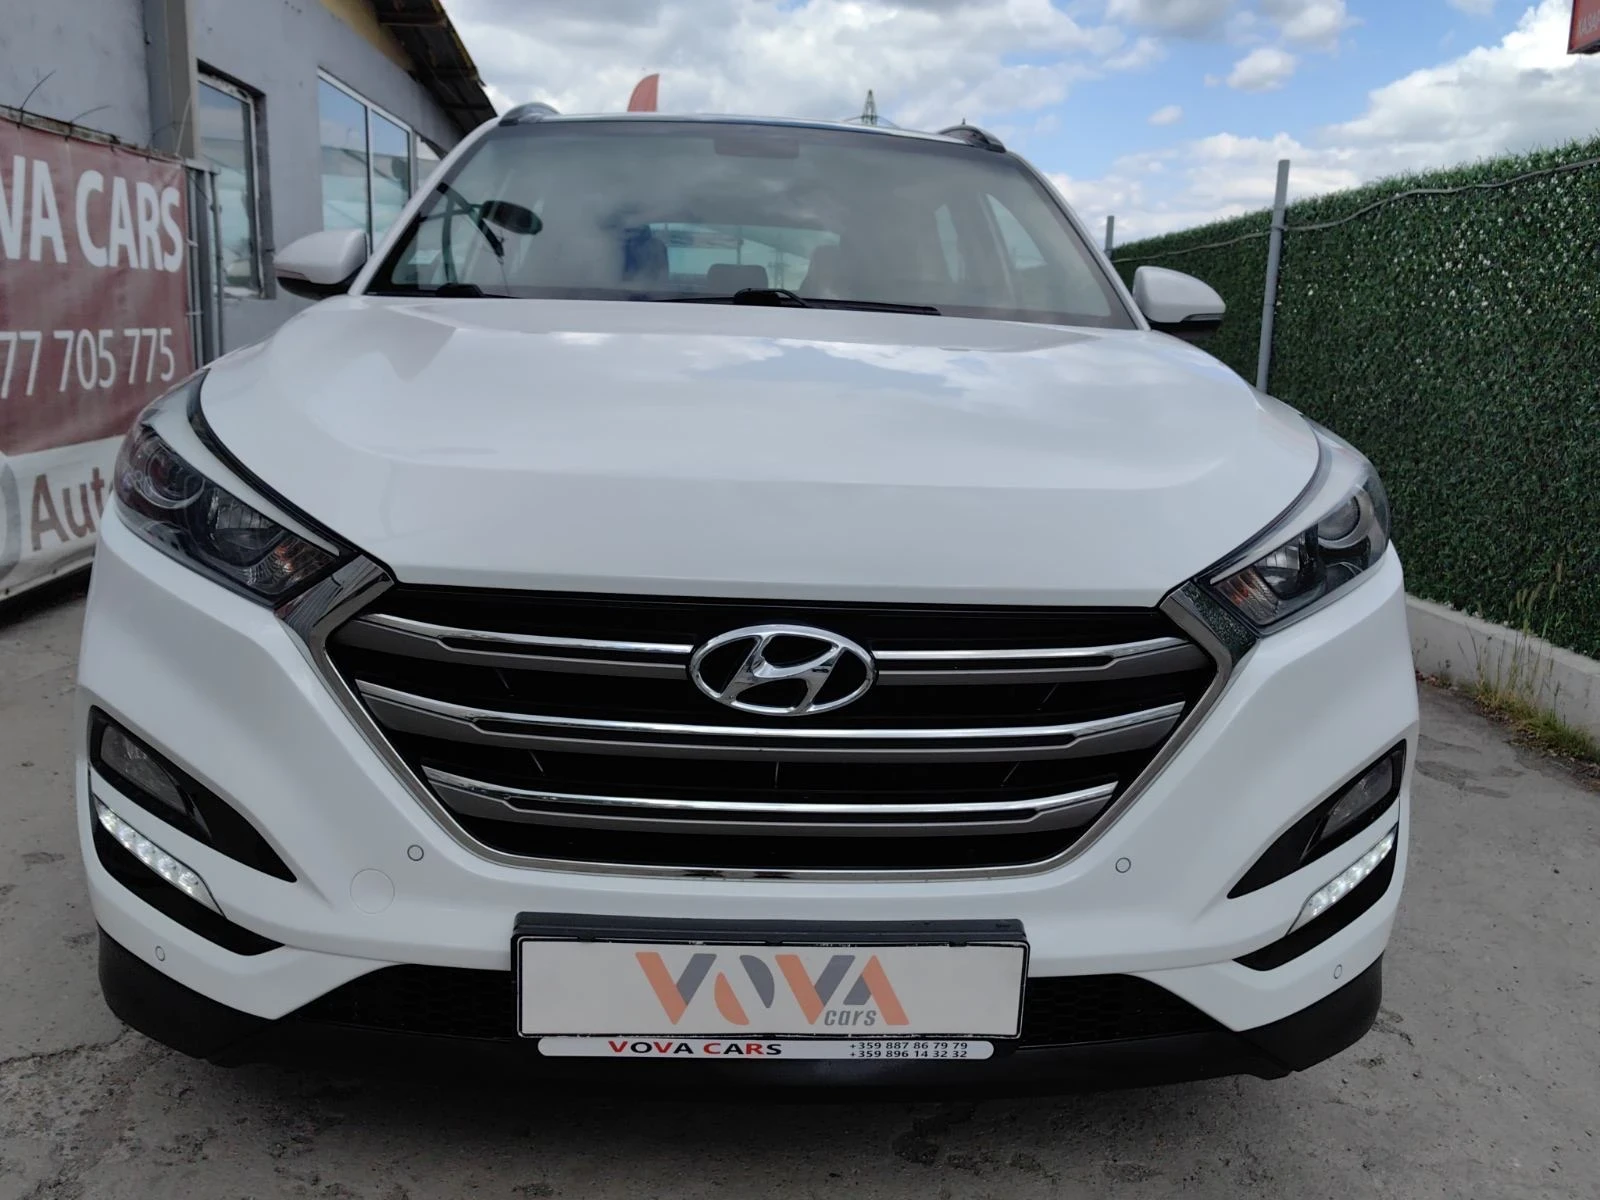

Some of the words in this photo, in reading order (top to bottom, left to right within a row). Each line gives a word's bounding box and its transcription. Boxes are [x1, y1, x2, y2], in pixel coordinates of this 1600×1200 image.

[76, 170, 183, 272] CARS
[54, 329, 116, 392] 705
[124, 327, 174, 384] 775
[31, 467, 113, 552] Aut
[635, 951, 910, 1026] VOVA
[823, 1009, 878, 1027] cars
[608, 1040, 694, 1055] VOVA
[703, 1042, 782, 1056] CARS
[885, 1041, 909, 1050] 887
[913, 1041, 929, 1050] 86
[933, 1041, 948, 1050] 79
[952, 1041, 968, 1050] 79
[885, 1050, 909, 1058] 896
[914, 1050, 928, 1058] 14
[932, 1050, 948, 1058] 32
[952, 1050, 968, 1058] 32
